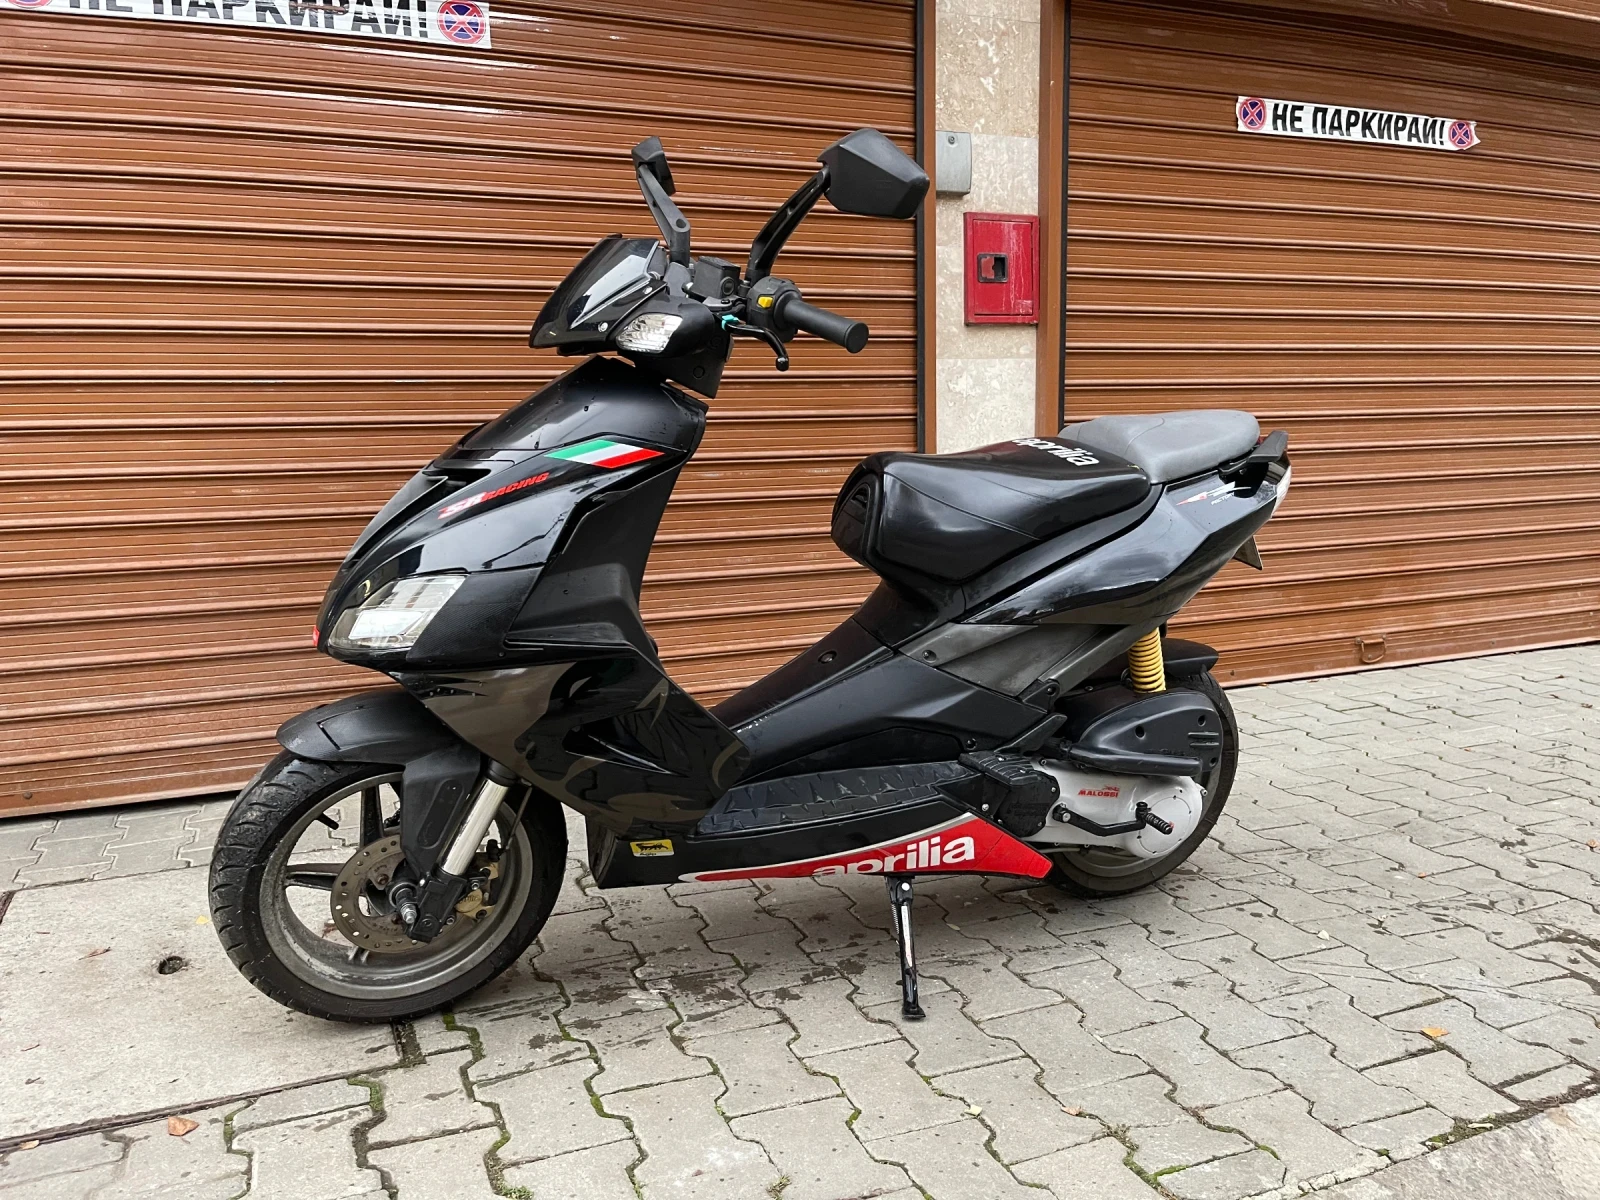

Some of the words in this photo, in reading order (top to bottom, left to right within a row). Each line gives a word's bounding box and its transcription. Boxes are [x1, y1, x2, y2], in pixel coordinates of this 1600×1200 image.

[1272, 103, 1304, 132] НЕ
[481, 472, 550, 503] RACING
[1078, 789, 1119, 798] MALOSSI
[811, 836, 975, 876] aprilia
